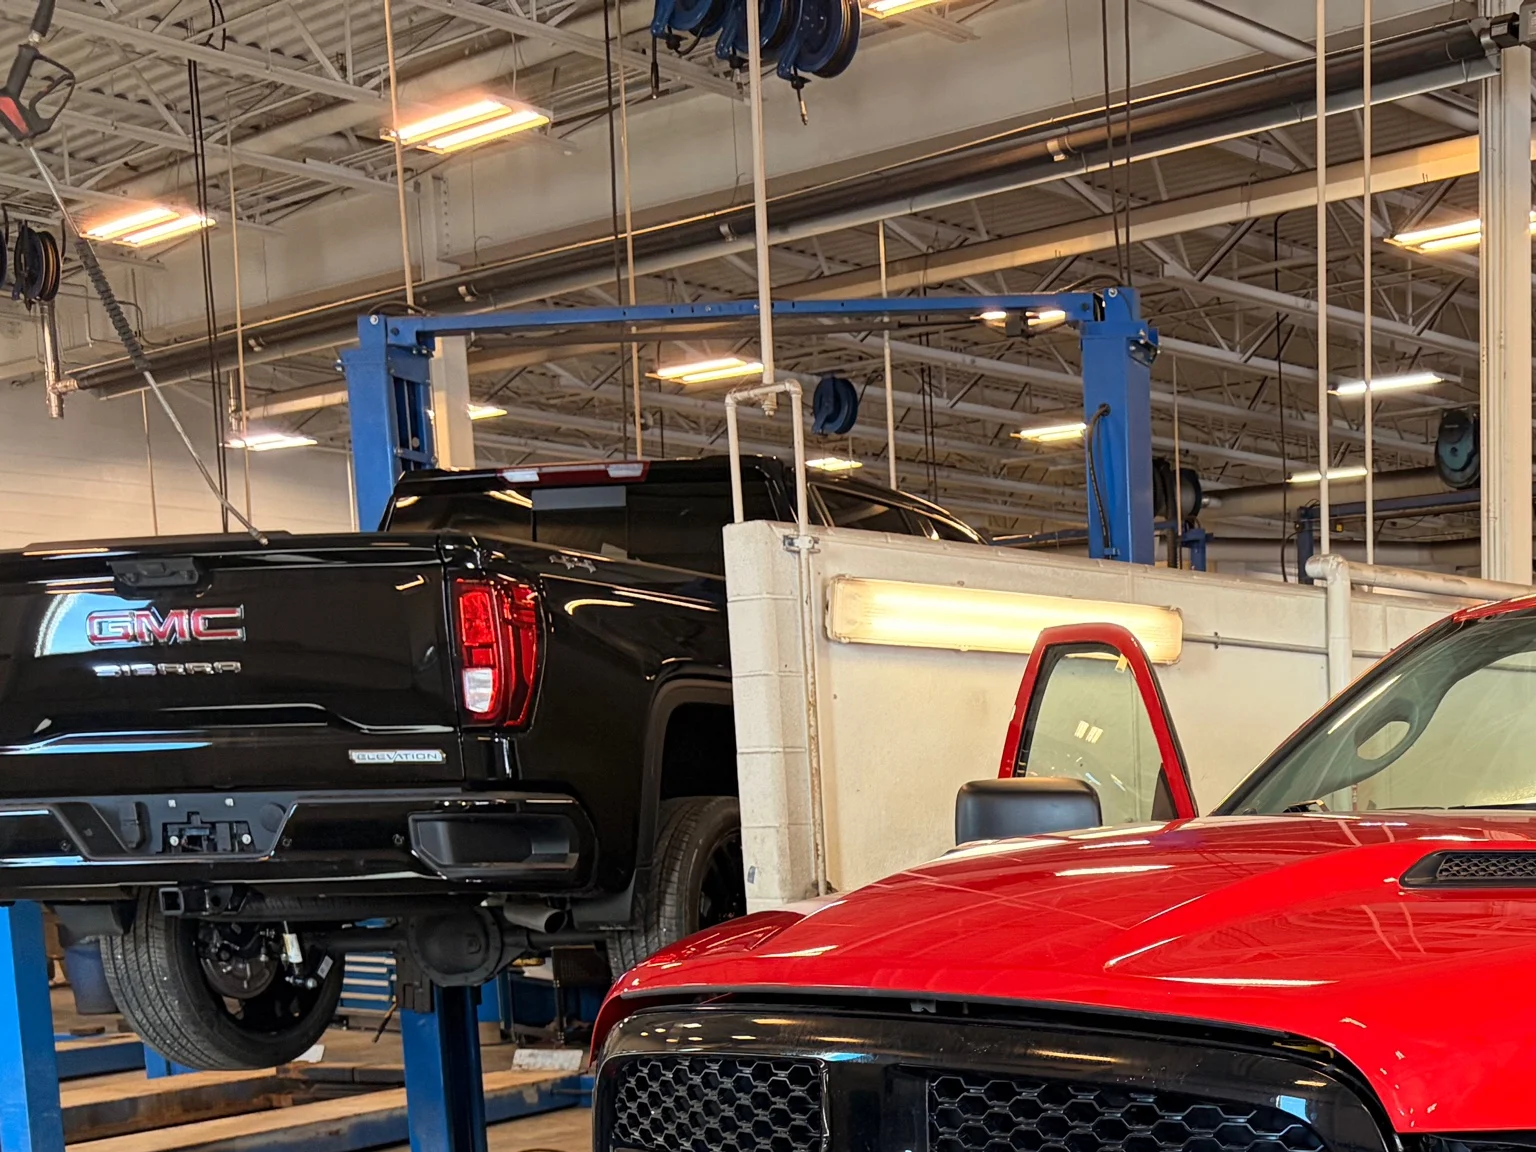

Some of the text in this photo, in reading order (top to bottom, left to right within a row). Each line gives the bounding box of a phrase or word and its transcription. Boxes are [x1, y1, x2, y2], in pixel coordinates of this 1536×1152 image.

[86, 604, 246, 646] GMC
[92, 662, 242, 677] SIERRA
[356, 751, 438, 762] ELEVATION
